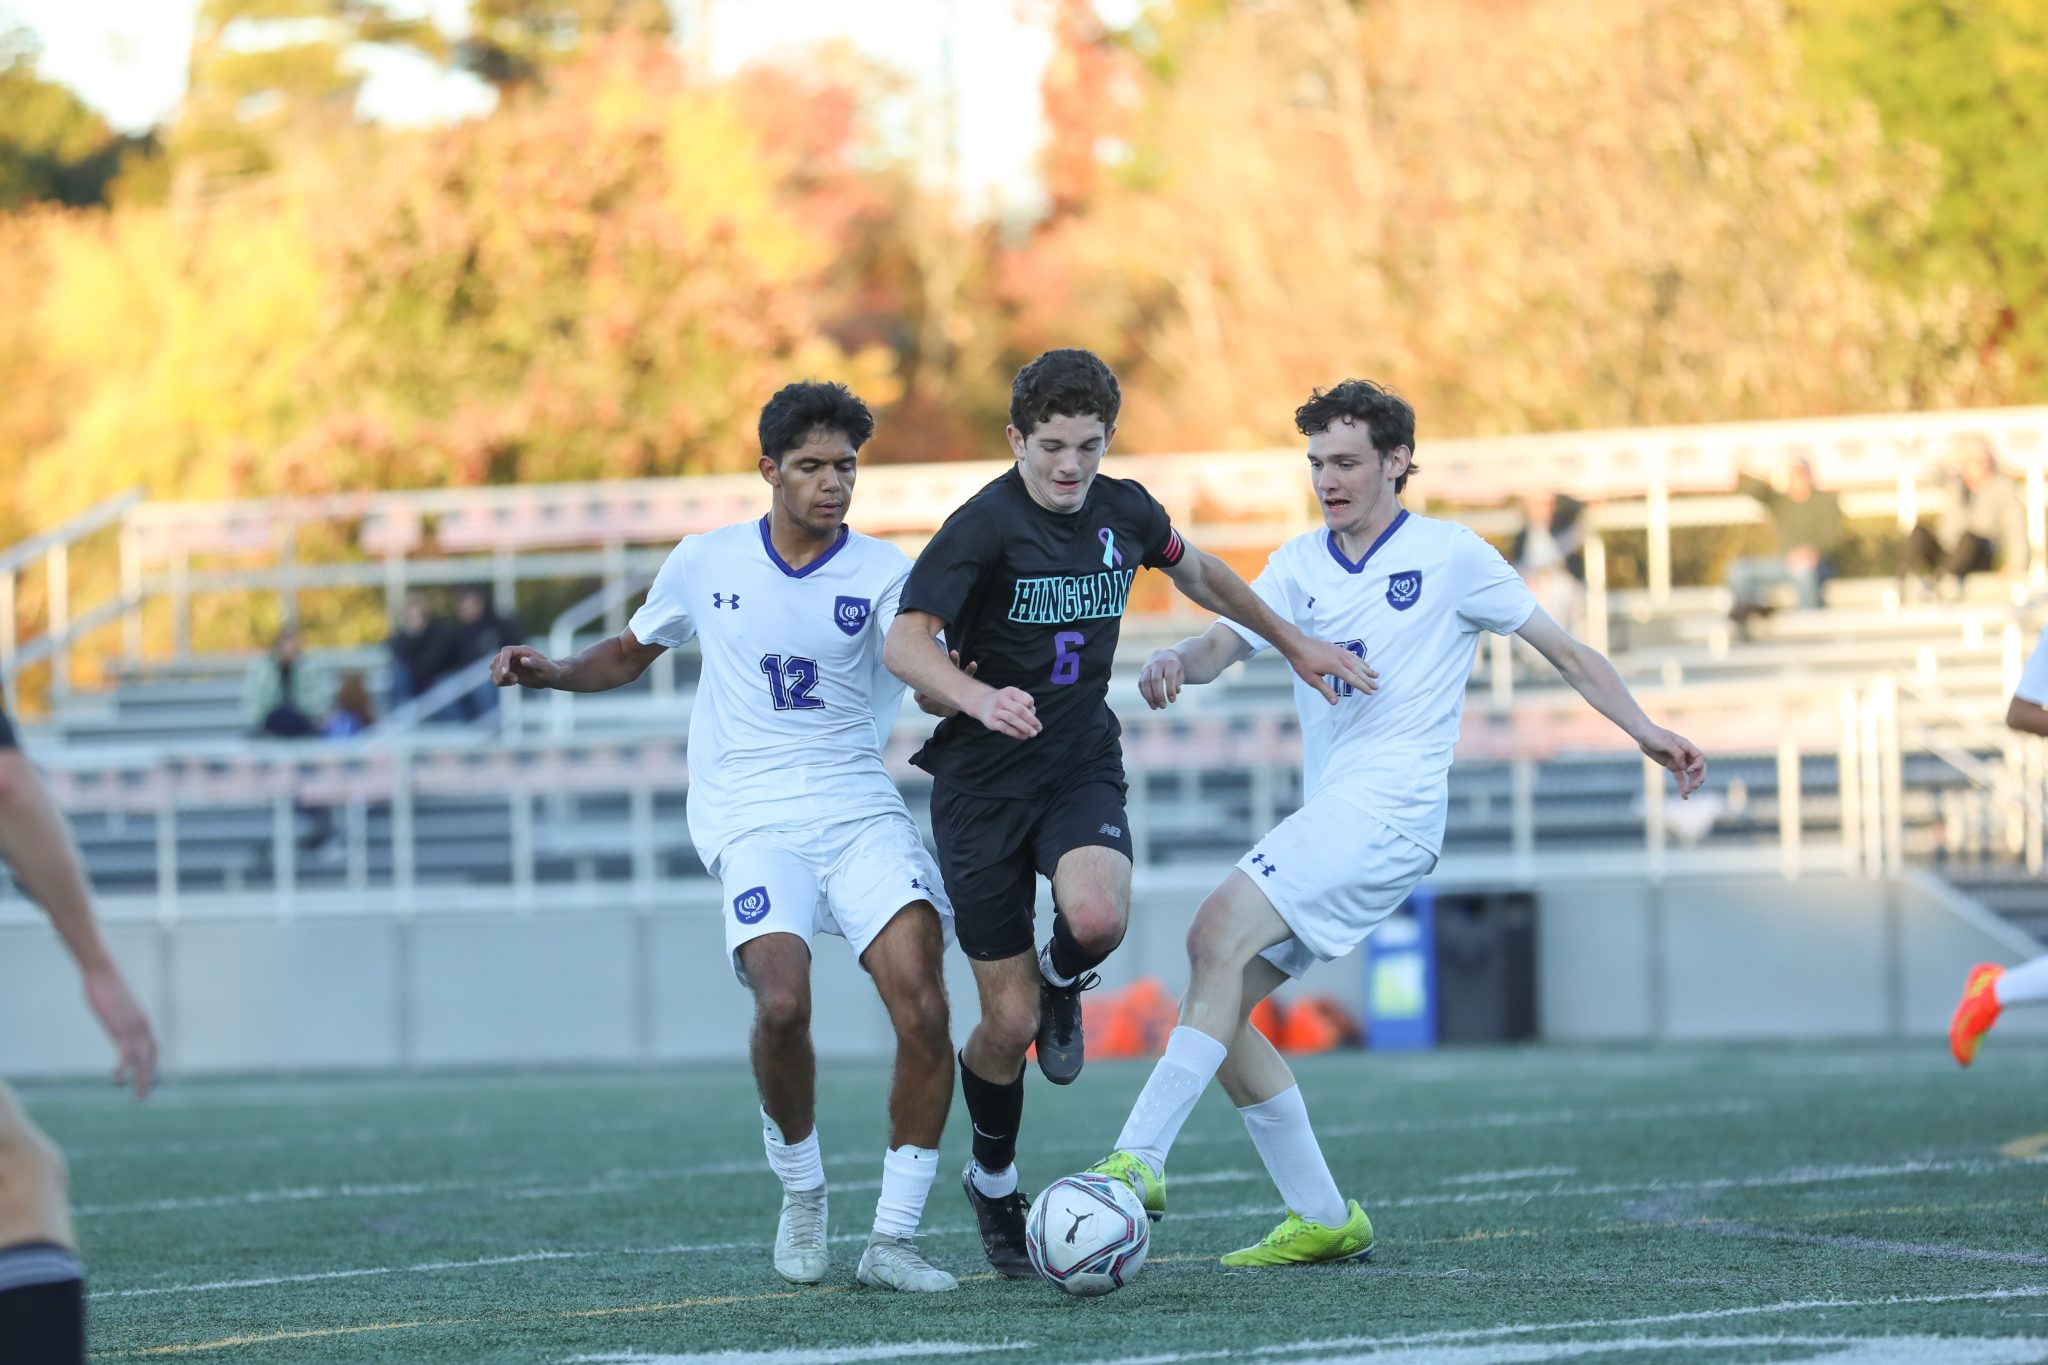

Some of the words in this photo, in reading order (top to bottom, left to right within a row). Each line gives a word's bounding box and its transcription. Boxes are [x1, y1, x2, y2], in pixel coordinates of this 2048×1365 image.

[1008, 569, 1132, 624] HINGHAM
[760, 654, 825, 711] 12
[1050, 631, 1085, 685] 6
